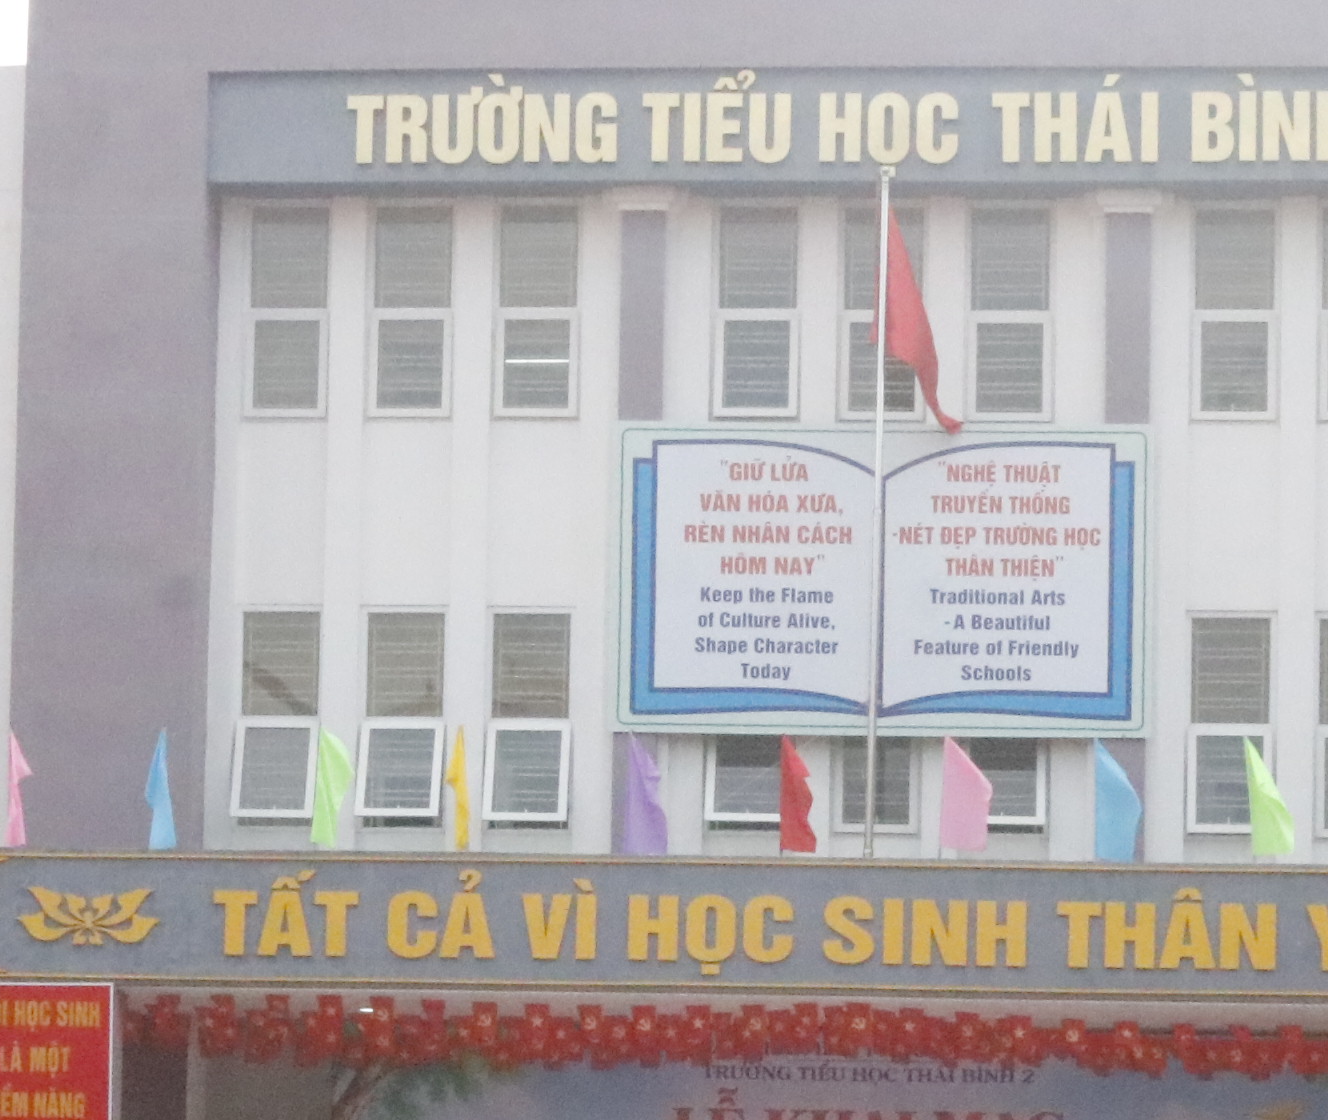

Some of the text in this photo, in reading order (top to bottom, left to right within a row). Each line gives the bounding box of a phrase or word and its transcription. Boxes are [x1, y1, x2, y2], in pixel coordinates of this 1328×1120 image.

[348, 73, 617, 166] TRƯỜNG
[643, 68, 792, 166] TIỂU
[819, 90, 960, 175] HỌC
[992, 73, 1159, 166] THÁI
[771, 456, 809, 482] LỬA
[1004, 462, 1061, 488] THUẬT
[700, 488, 843, 516] VĂN HÓA XƯA,
[931, 487, 1070, 515] TRUYỀN THỐNG
[684, 521, 852, 545] RÈN NHÂN CÁCH
[940, 527, 976, 550] ĐẸP
[983, 522, 1057, 546] TRƯỜNG
[1064, 527, 1101, 551] HỌC
[720, 552, 767, 575] HÔM
[945, 554, 994, 577] THÂN
[700, 587, 834, 605] Keep the Flame
[929, 588, 1066, 606] Traditional Arts
[698, 612, 835, 631] of Culture Alive,
[972, 615, 1050, 631] Beautiful
[695, 637, 839, 655] Shape Character
[914, 639, 1079, 659] Feature of Friendly
[741, 663, 791, 681] Today
[961, 665, 1032, 681] Schools
[213, 869, 358, 960] TẤT
[385, 869, 494, 960] CẢ
[522, 878, 598, 962] VÌ
[627, 893, 794, 975] HỌC
[822, 895, 1029, 970] SINH
[1056, 886, 1278, 971] THÂN
[14, 1000, 51, 1032] HỌC
[56, 1000, 101, 1028] SINH
[0, 1041, 70, 1079] LÀ MỘT
[1022, 1068, 1035, 1085] 2
[33, 1088, 86, 1120] NĂNG
